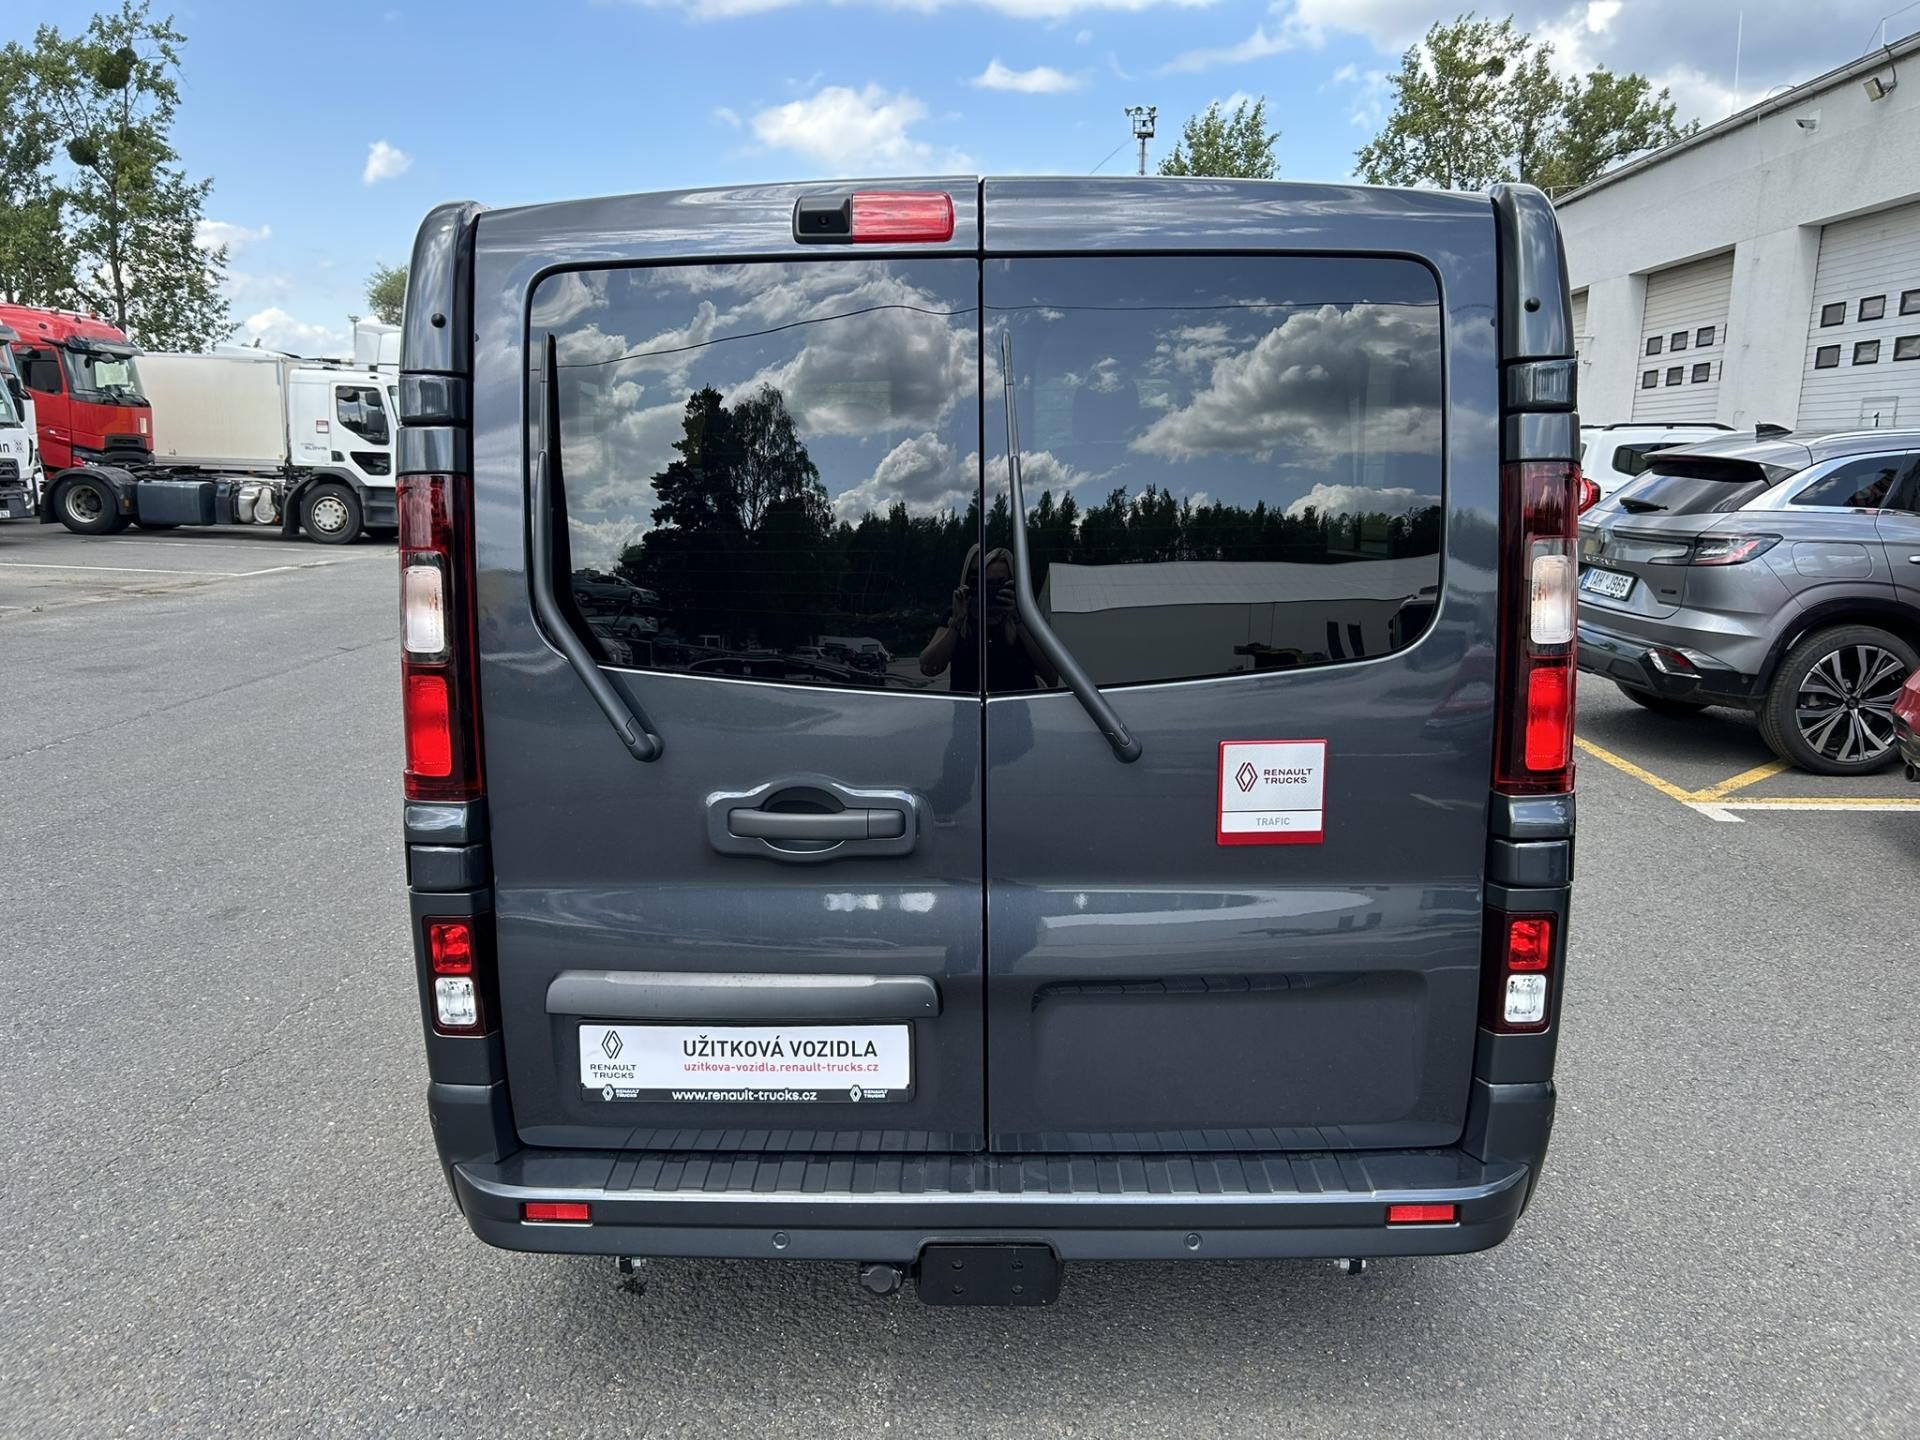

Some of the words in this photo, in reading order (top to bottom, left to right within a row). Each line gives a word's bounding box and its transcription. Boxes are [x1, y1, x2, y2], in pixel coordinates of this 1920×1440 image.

[1263, 768, 1313, 776] RENAULT
[1263, 776, 1308, 785] TRUCKS
[1255, 817, 1291, 826] TRAFIC
[683, 1034, 785, 1057] UŽITKOVÁ
[789, 1040, 878, 1057] VOZIDLA
[590, 1063, 638, 1071] RENAULT
[683, 1061, 880, 1072] uzitkova-vozidla.renault-trucks.cz
[593, 1071, 635, 1079] TRUCKS
[671, 1089, 817, 1101] www.renault-trucks.cz
